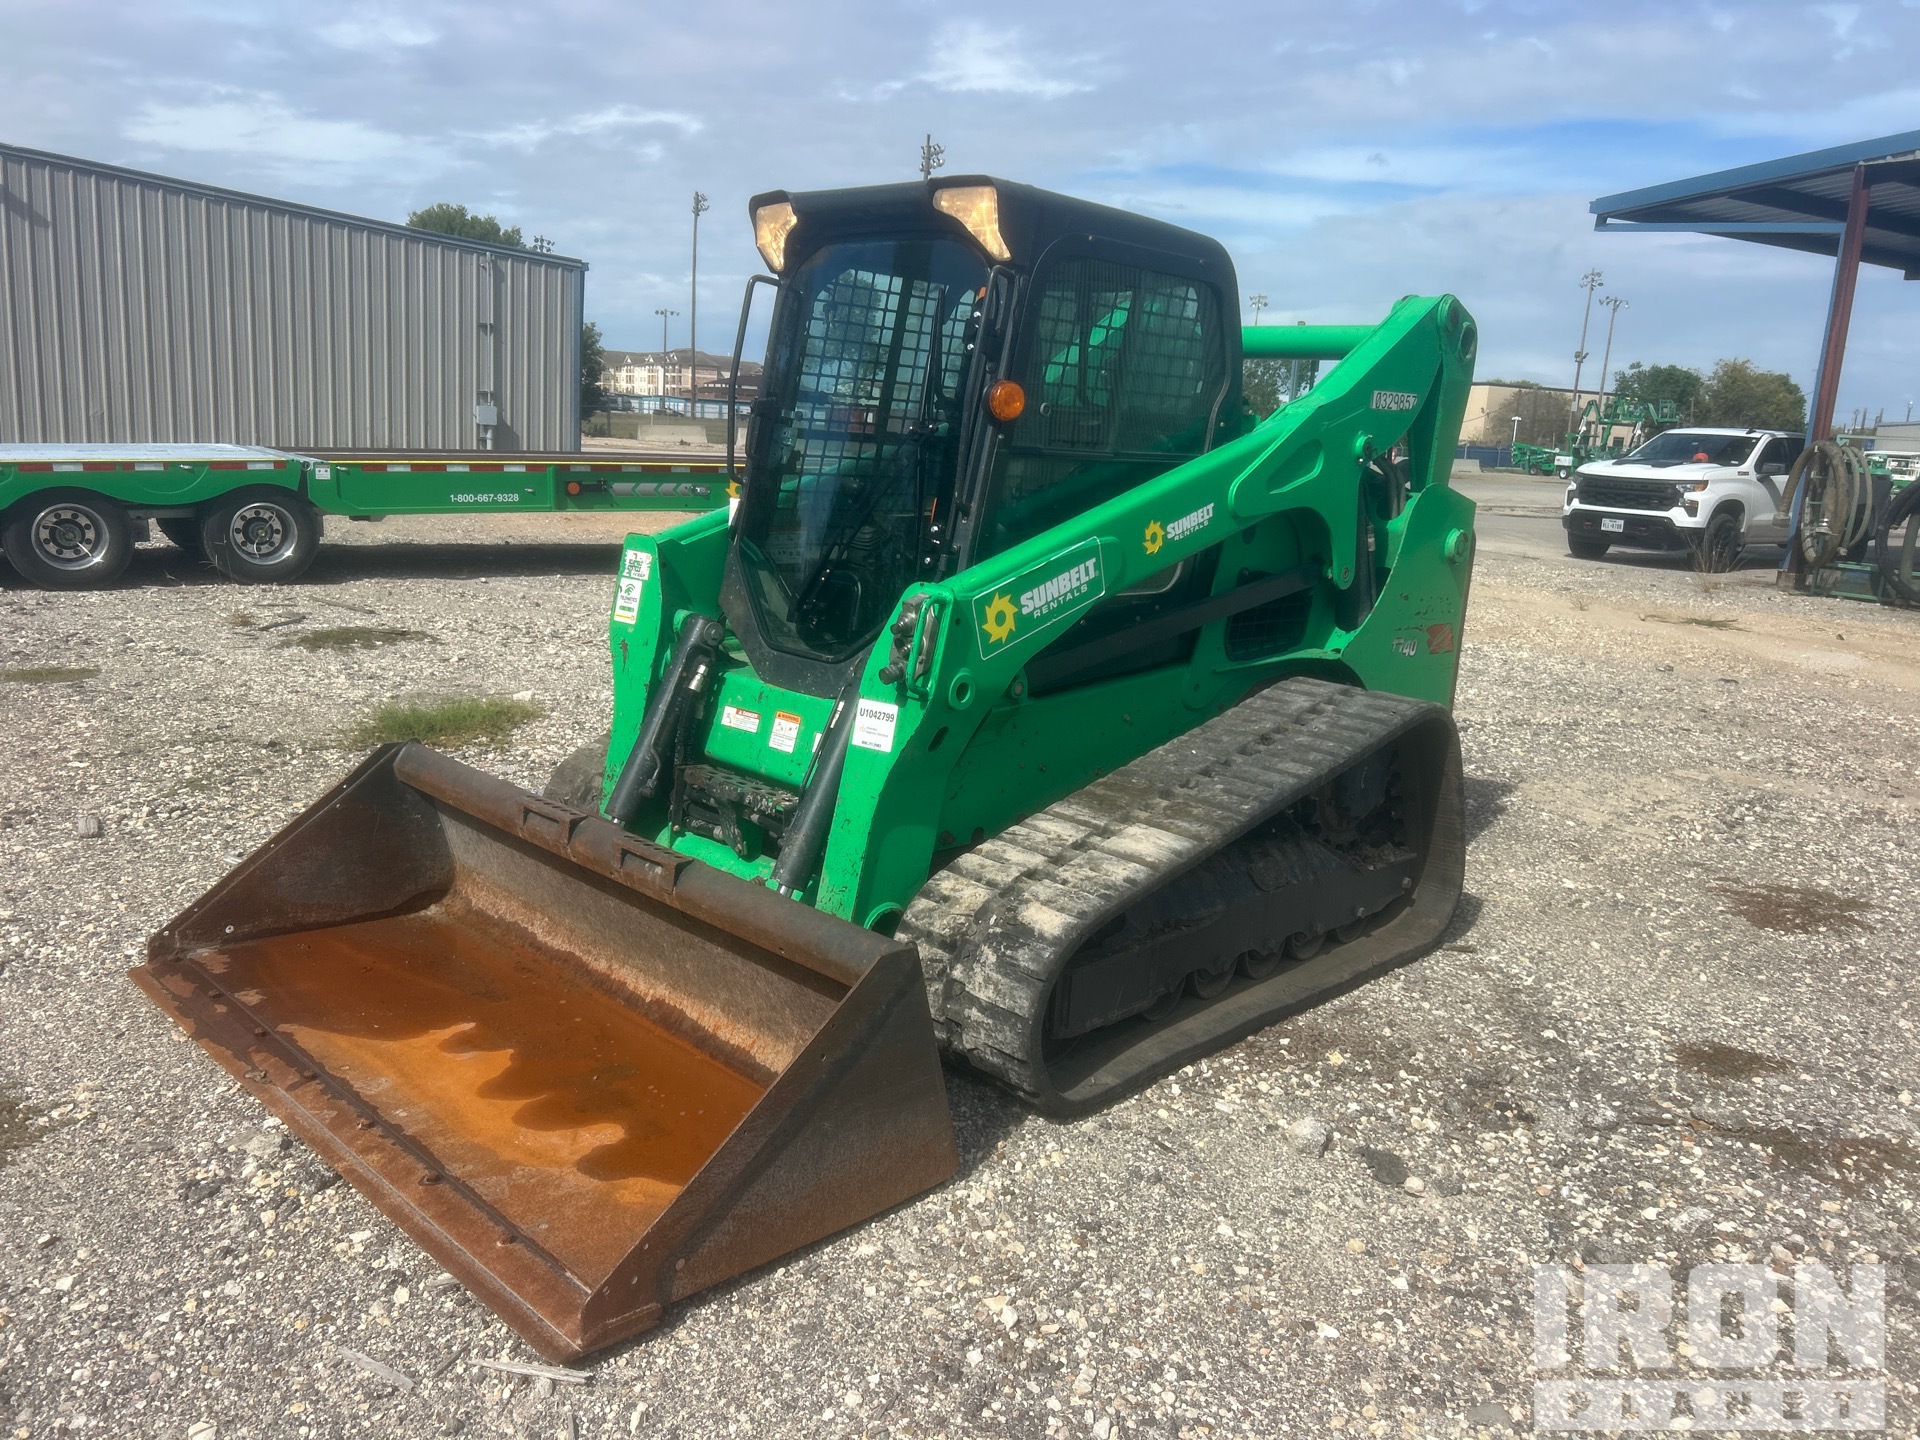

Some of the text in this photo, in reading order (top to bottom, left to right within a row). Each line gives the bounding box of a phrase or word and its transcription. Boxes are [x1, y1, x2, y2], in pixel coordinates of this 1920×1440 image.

[450, 493, 519, 503] 1-800-667-9328
[1166, 502, 1215, 539] SUNBELT
[1174, 520, 1209, 541] RENTALS
[1020, 557, 1097, 616] SUNBELT
[1033, 583, 1088, 619] RENTALS
[781, 713, 800, 723] WARNING
[859, 707, 895, 723] U1042799
